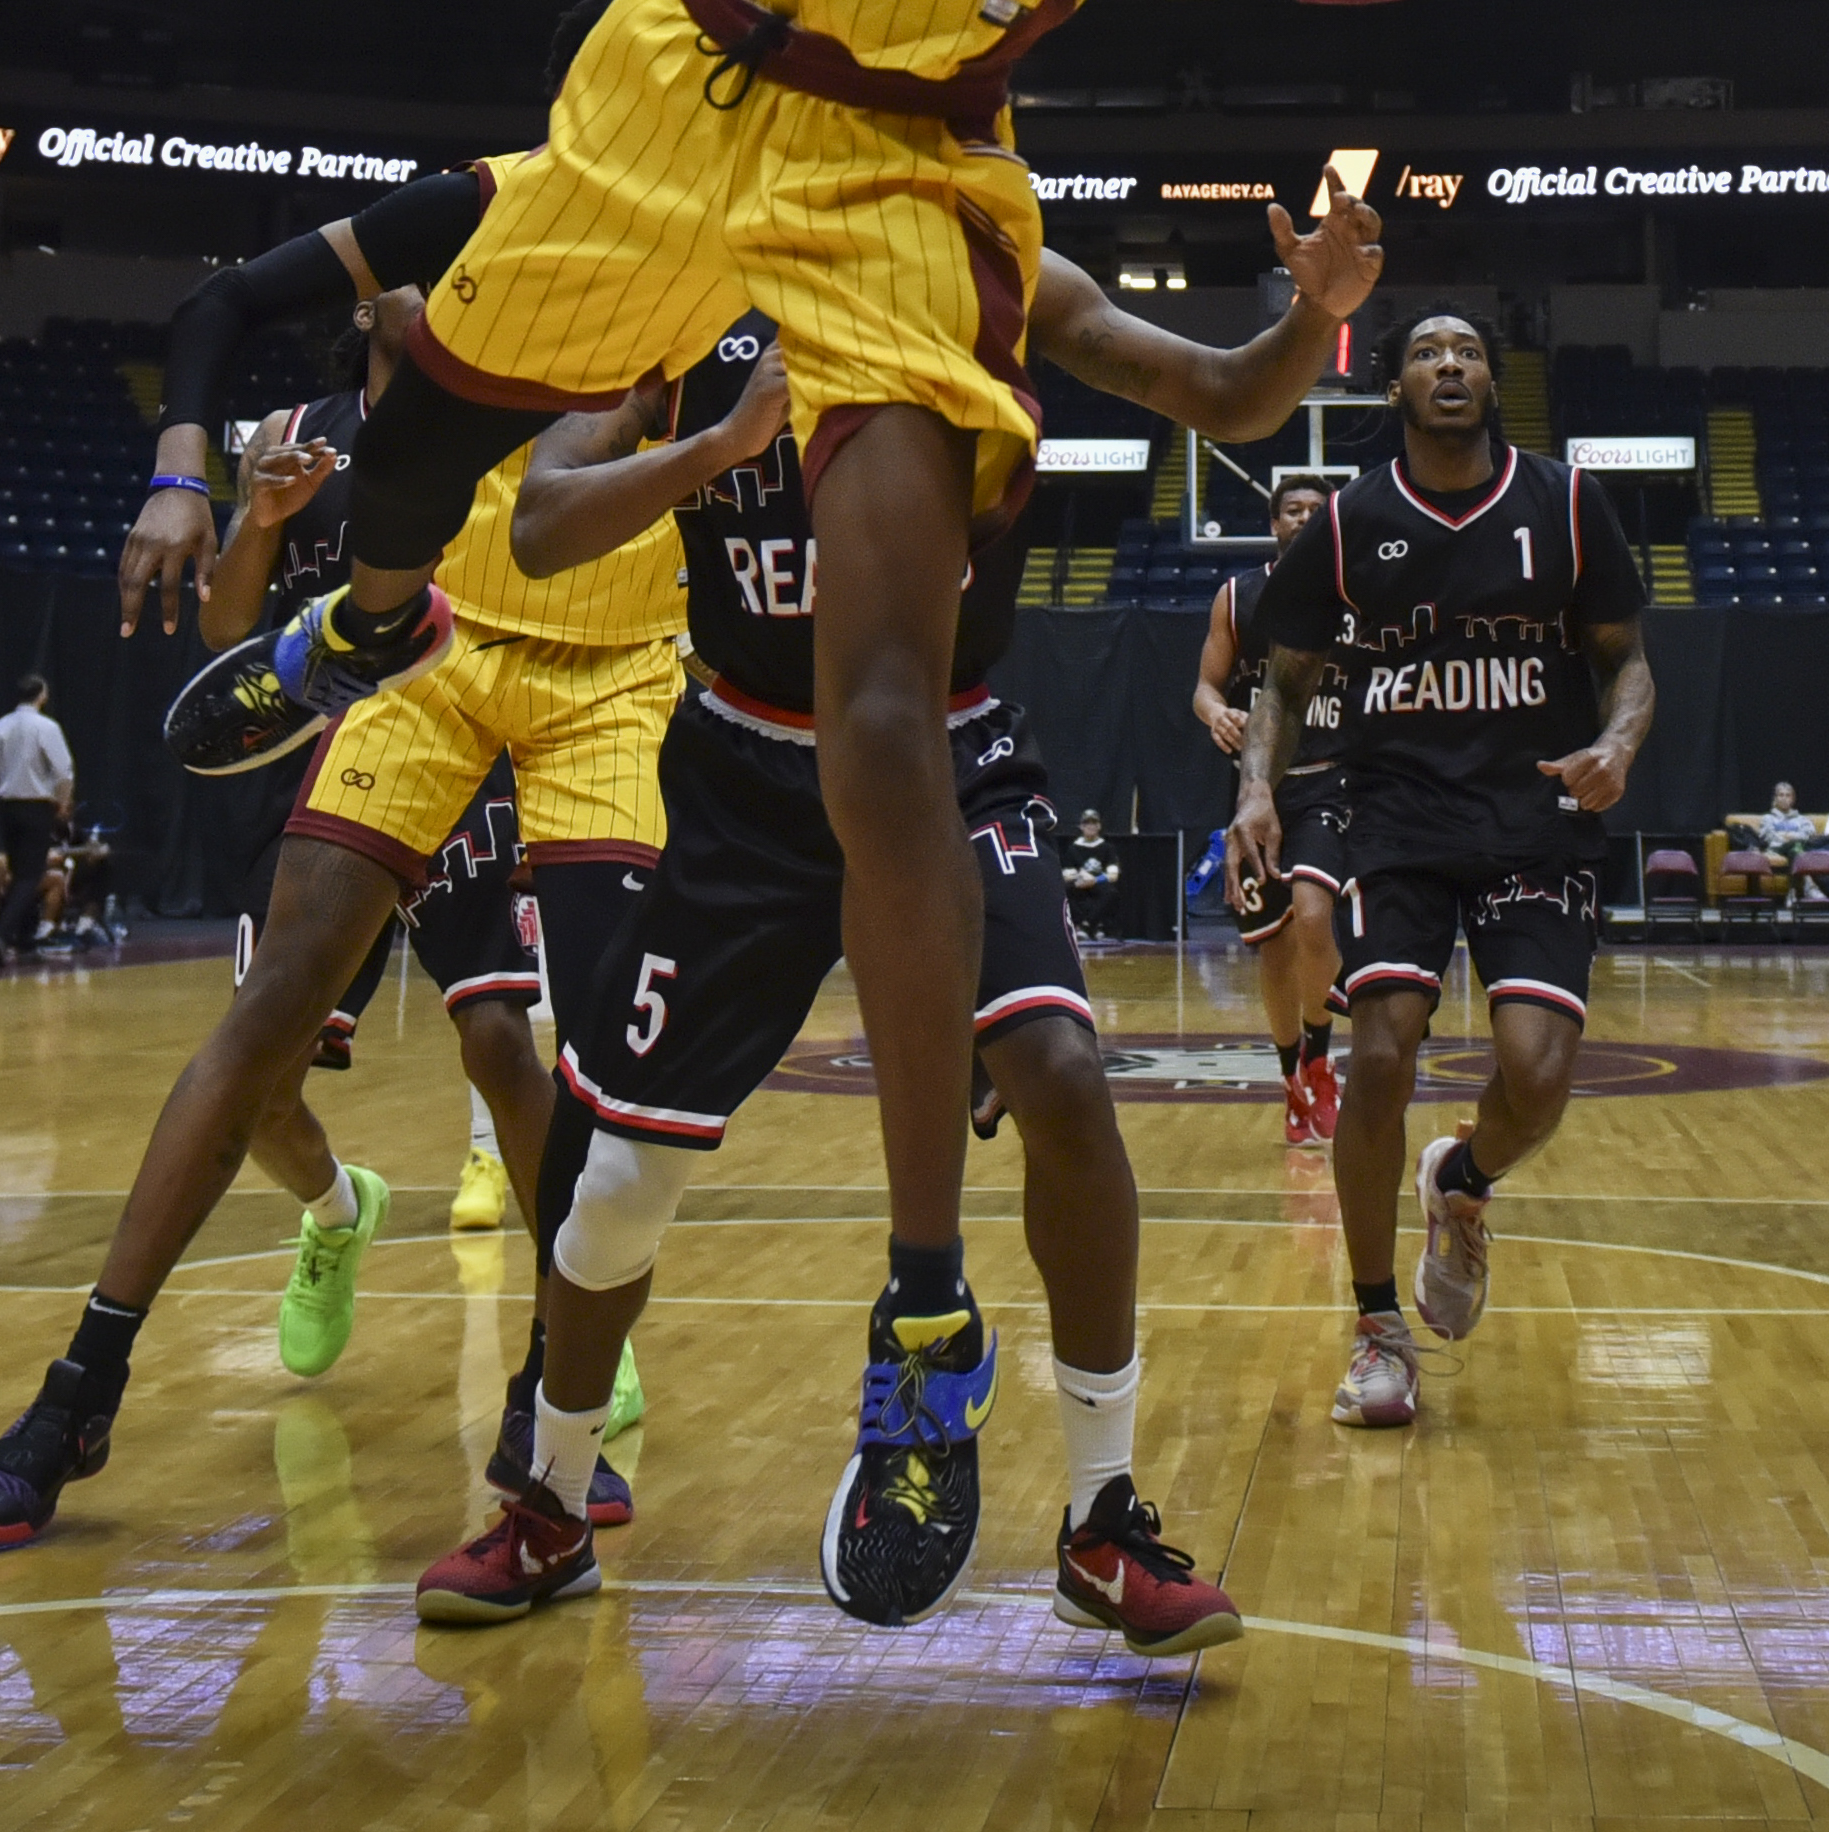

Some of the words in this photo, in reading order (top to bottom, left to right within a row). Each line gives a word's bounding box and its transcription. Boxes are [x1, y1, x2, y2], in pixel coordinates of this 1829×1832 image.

[38, 127, 155, 167] Official
[160, 136, 292, 175] Creative
[296, 146, 418, 183] Partner
[1487, 165, 1598, 204] Official
[1604, 164, 1733, 195] Creative
[1094, 451, 1145, 465] LIGHT
[1572, 442, 1632, 465] Coors
[1636, 449, 1688, 464] LIGHT
[1513, 526, 1533, 580] 1
[1335, 613, 1357, 645] 3
[1363, 656, 1546, 714] READING
[1340, 876, 1366, 939] 1
[626, 952, 678, 1058] 5
